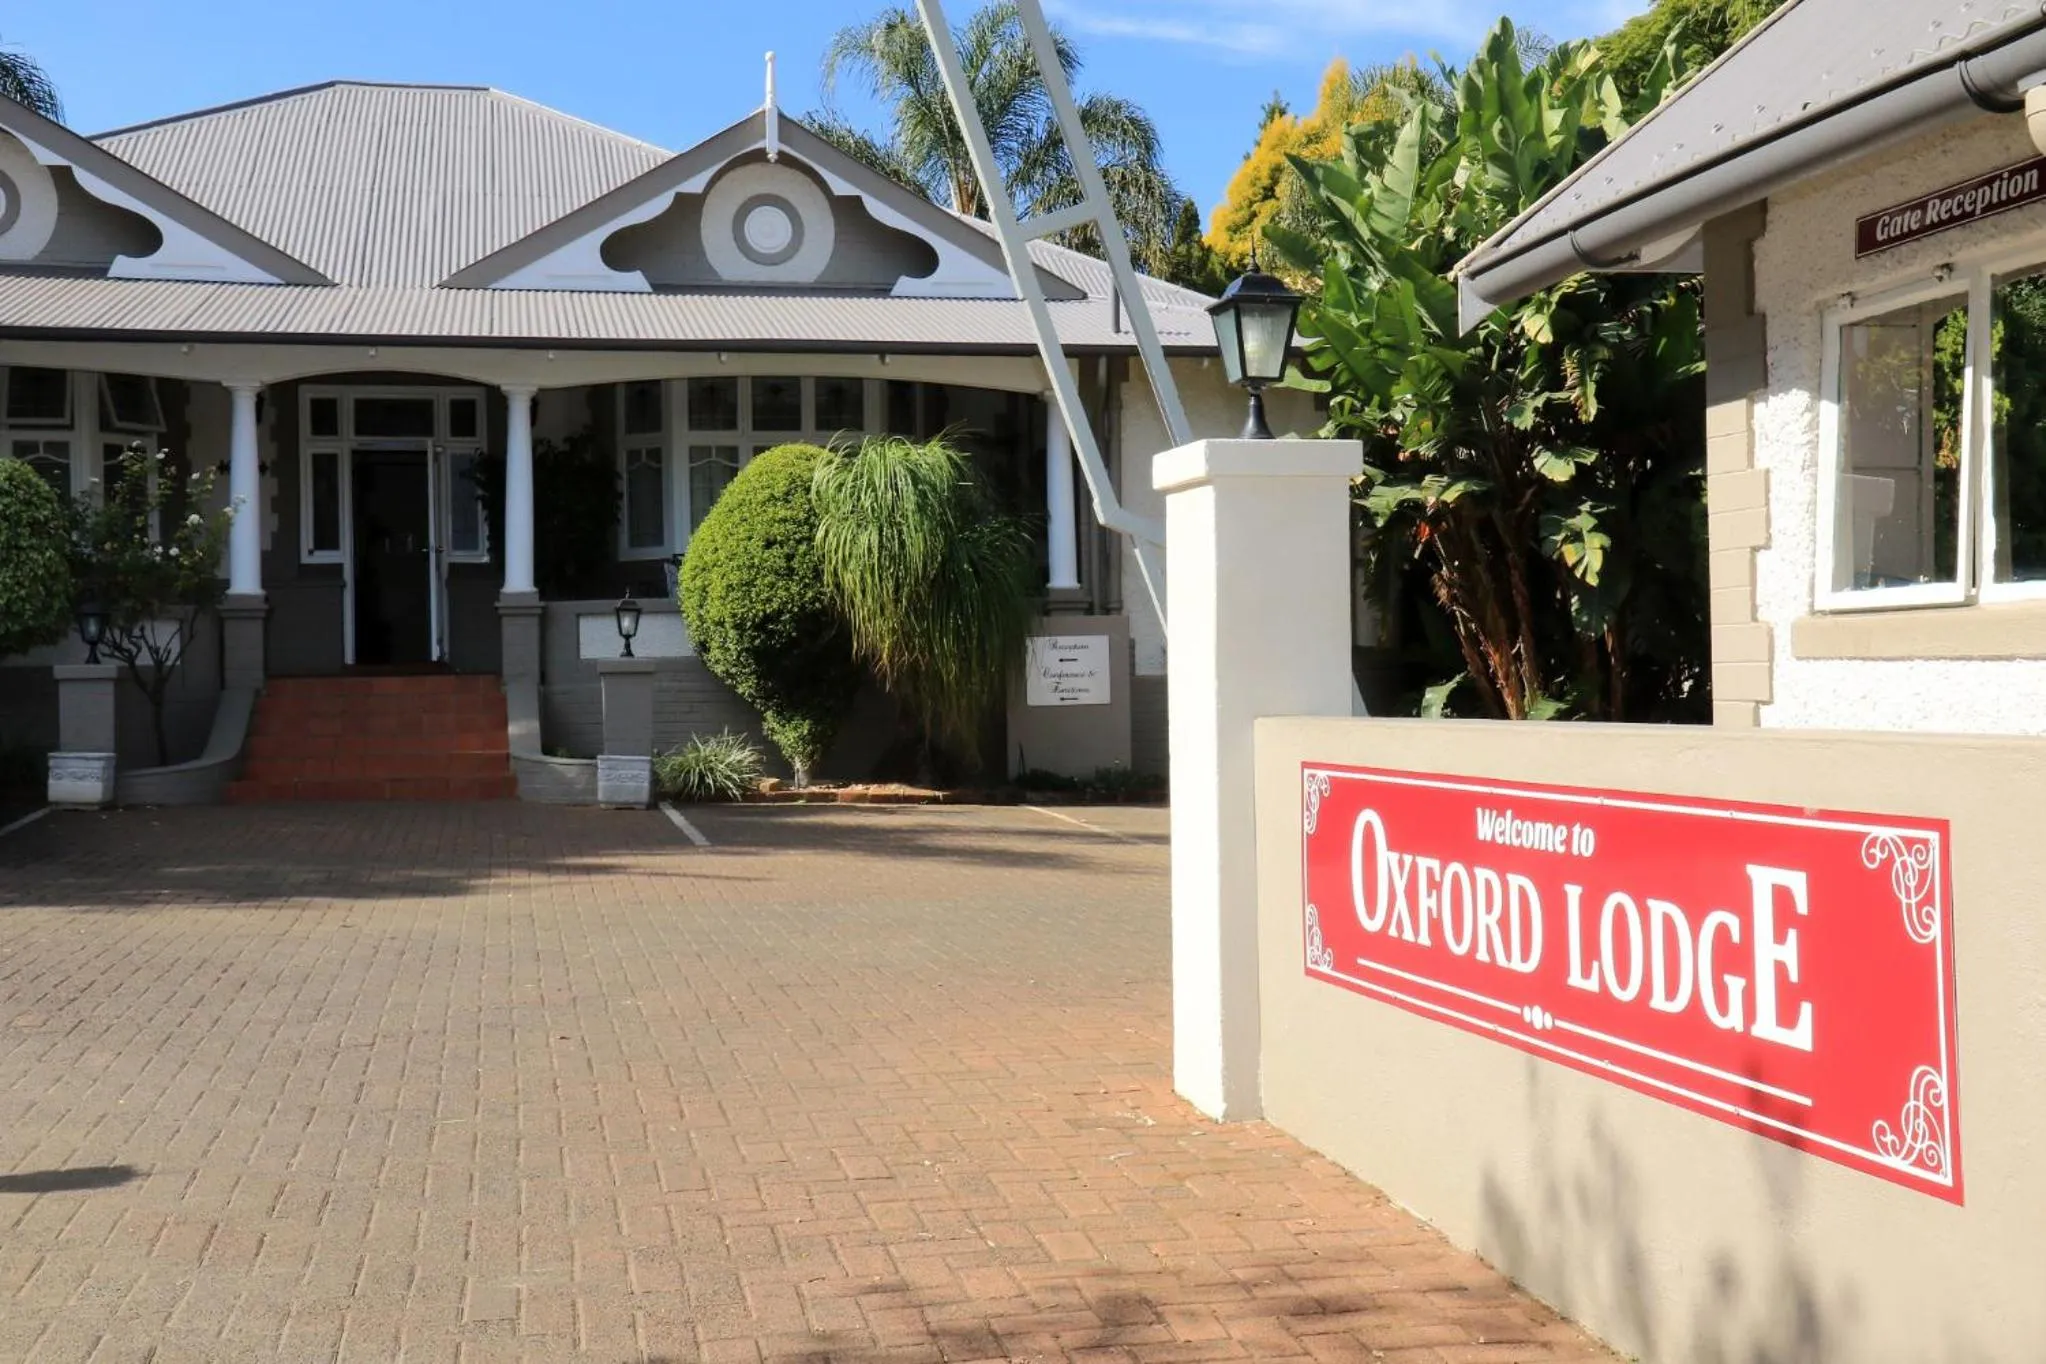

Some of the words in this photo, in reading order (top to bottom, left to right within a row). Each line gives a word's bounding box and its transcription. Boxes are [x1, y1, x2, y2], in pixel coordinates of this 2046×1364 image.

[1876, 209, 1921, 241] Gate
[1925, 168, 2038, 225] Reception
[1475, 806, 1568, 853] Welcome
[1571, 823, 1595, 858] to
[1351, 808, 1543, 973] OXFORD
[1563, 864, 1813, 1052] LODGE
